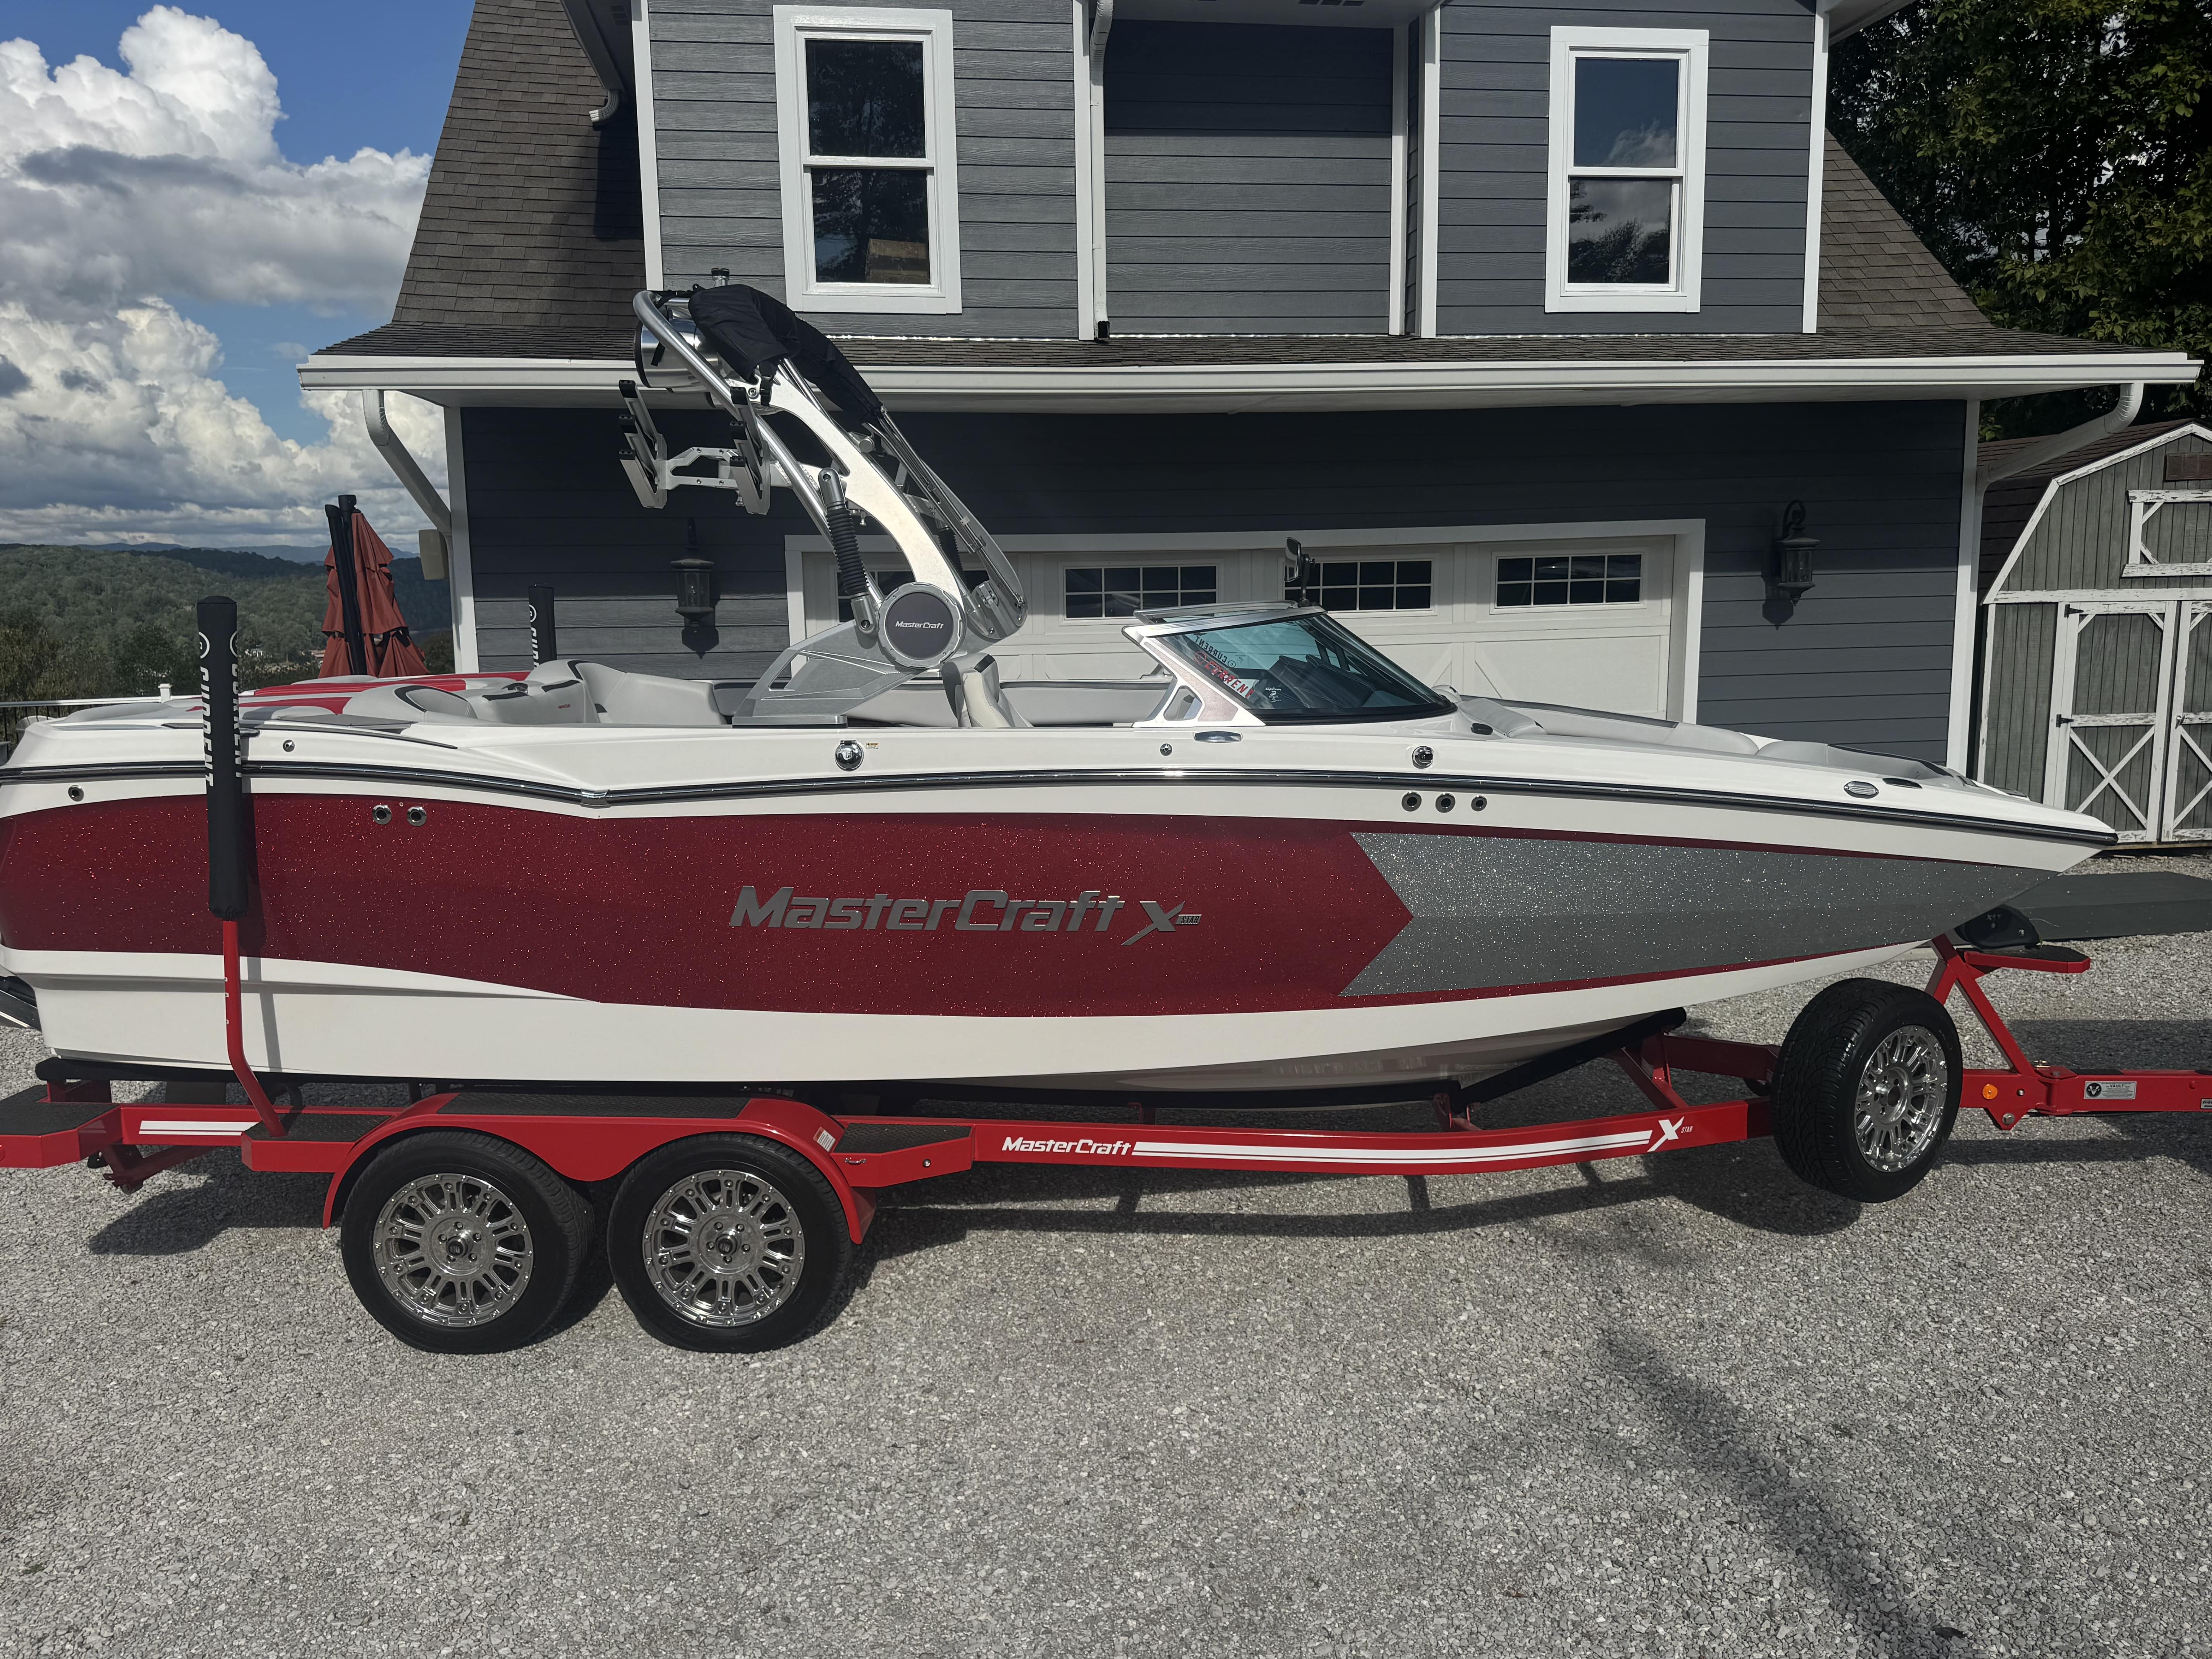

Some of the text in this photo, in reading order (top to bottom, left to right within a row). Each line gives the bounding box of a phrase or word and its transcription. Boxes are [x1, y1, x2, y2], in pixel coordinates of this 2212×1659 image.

[895, 621, 944, 629] MasterCraft
[1204, 660, 1255, 698] CURRENT
[730, 885, 1200, 945] MasterCraft X STAR
[1001, 1137, 1131, 1155] MasterCraft
[1647, 1115, 1693, 1152] X STAR
